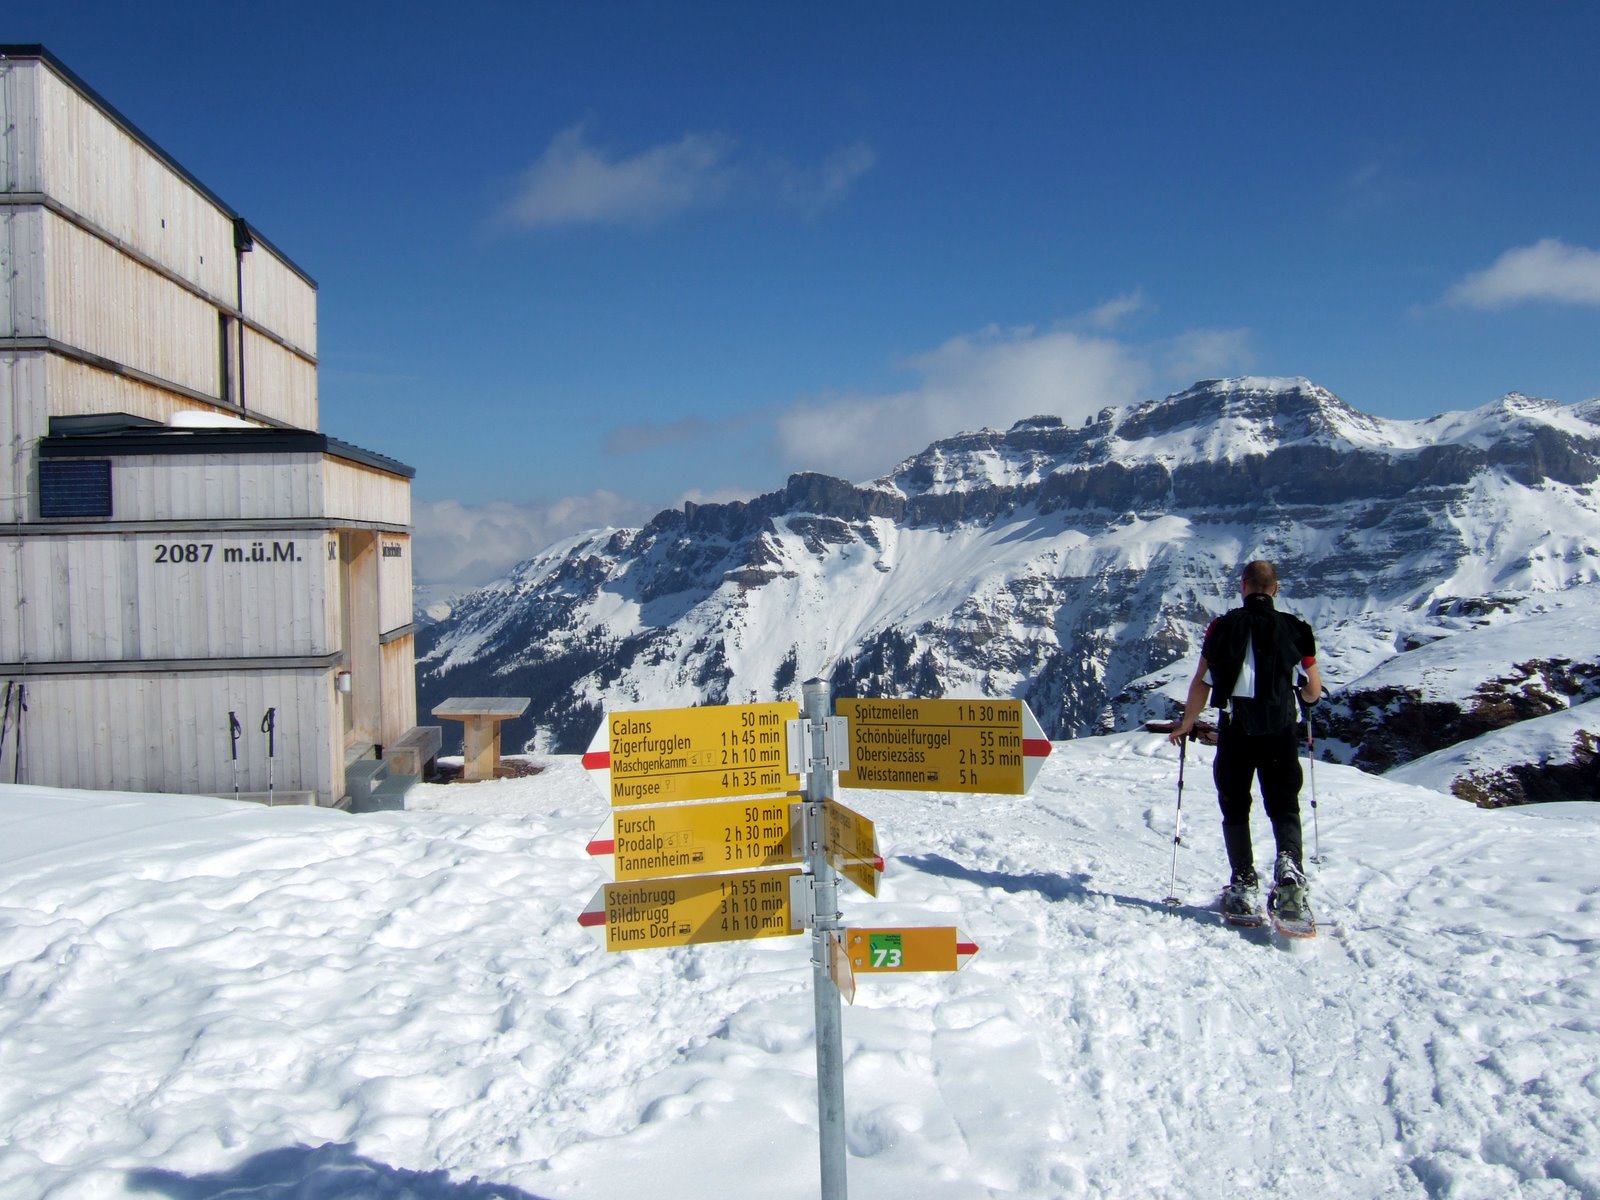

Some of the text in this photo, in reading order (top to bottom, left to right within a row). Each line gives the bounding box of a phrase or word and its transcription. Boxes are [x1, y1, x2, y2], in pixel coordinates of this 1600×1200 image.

[154, 542, 302, 564] 2087 m.ü.M.
[612, 710, 779, 736] Calans 50 min
[855, 704, 1019, 723] Spitzmeilen 1 h 30 min
[612, 730, 780, 757] Zigerfurgglen 1 h 45 min
[856, 729, 1020, 749] Schönbüelfurggel 55 min
[613, 748, 780, 774] Maschgenkamm 2 h 10 min
[856, 747, 1021, 766] Obersiezsäss 2 h 35 min
[614, 771, 781, 799] Murgsee 4 h 35 min
[857, 766, 977, 785] Weisstannen 5 h
[618, 805, 782, 834] Fursch 50 min
[618, 824, 783, 853] Prodalp 2 h 30 min
[618, 842, 783, 871] Tannenheim 3 h 10 min
[609, 879, 782, 906] Steinbrugg 1 h 55 min
[610, 897, 783, 925] Bildbrugg 3 h 10 min
[611, 915, 783, 942] Flums Dorf 4 h 10 min
[873, 949, 902, 968] 73
